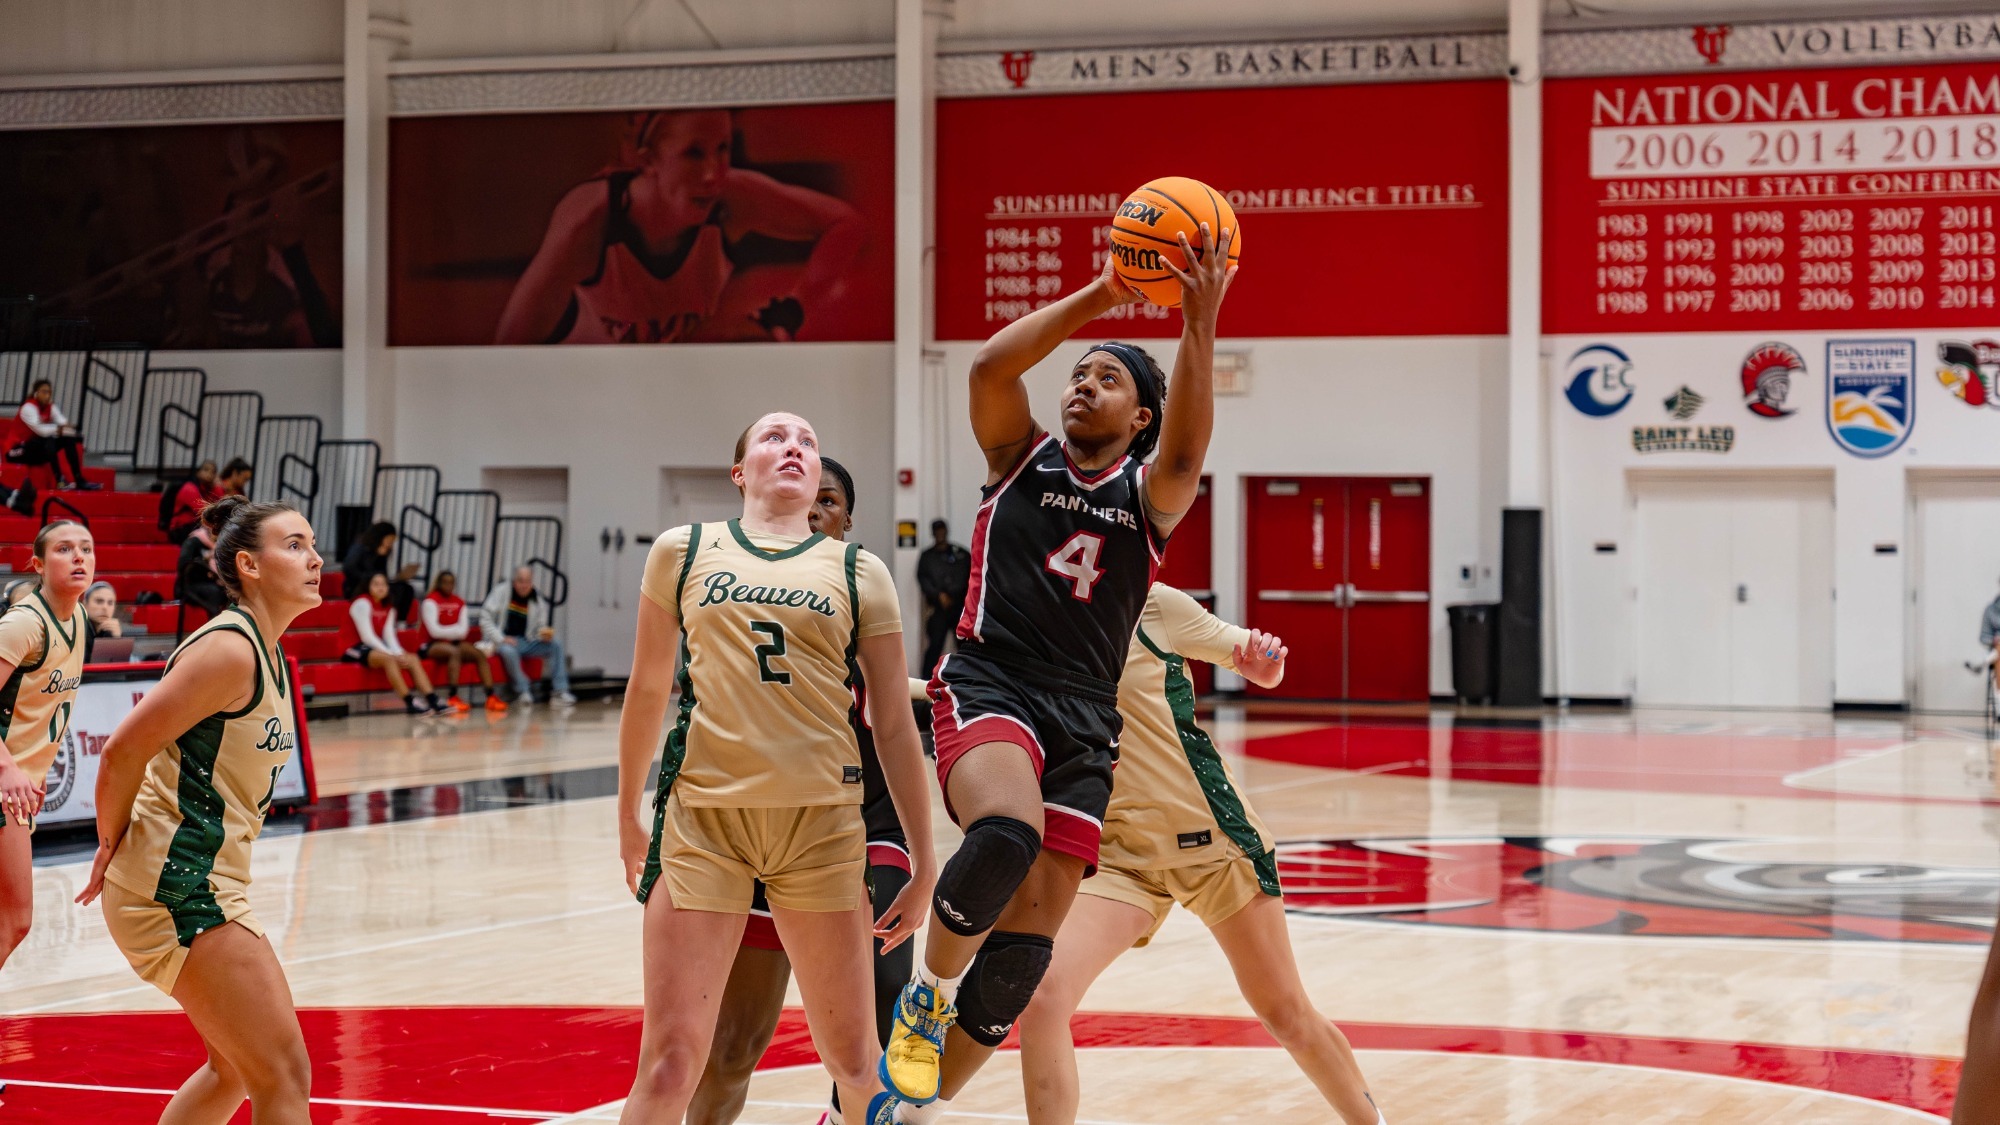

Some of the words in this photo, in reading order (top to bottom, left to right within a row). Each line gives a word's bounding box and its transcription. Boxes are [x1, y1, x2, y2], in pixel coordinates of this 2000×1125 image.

[1071, 48, 1191, 80] MEN'S
[1216, 41, 1473, 75] BASKETBALL
[1592, 81, 1838, 125] NATIONAL
[1614, 131, 1725, 170] 2006
[1747, 128, 1859, 167] 2014
[1884, 122, 1998, 163] 2018
[993, 193, 1120, 213] SUNSHINE
[1220, 186, 1379, 208] ONFERENCE
[1388, 183, 1476, 204] TITLES
[1606, 178, 1749, 200] SUNSHINE
[1758, 175, 1839, 197] STATE
[1664, 213, 1713, 235] 1991
[1732, 211, 1785, 234] 1998
[1799, 208, 1853, 232] 2002
[1868, 207, 1924, 230] 2007
[1938, 206, 1993, 229] 2011
[1664, 238, 1716, 261] 1992
[1732, 237, 1785, 259] 1999
[1799, 235, 1854, 258] 2003
[1868, 233, 1925, 256] 2008
[1938, 231, 1996, 256] 2012
[1597, 266, 1648, 288] 1987
[1664, 264, 1716, 287] 1996
[1730, 262, 1785, 286] 2000
[1868, 260, 1924, 283] 2009
[1938, 258, 1996, 282] 2013
[1664, 290, 1715, 313] 1997
[1730, 289, 1781, 312] 2001
[1798, 287, 1854, 311] 2006
[1867, 286, 1924, 310] 2010
[1938, 285, 1996, 309] 2014
[1632, 426, 1691, 442] SAINT
[1697, 426, 1735, 442] LEO
[1040, 491, 1138, 531] PANTHERS
[1044, 529, 1107, 604] 4
[698, 569, 837, 617] Beavers
[748, 618, 793, 687] 2
